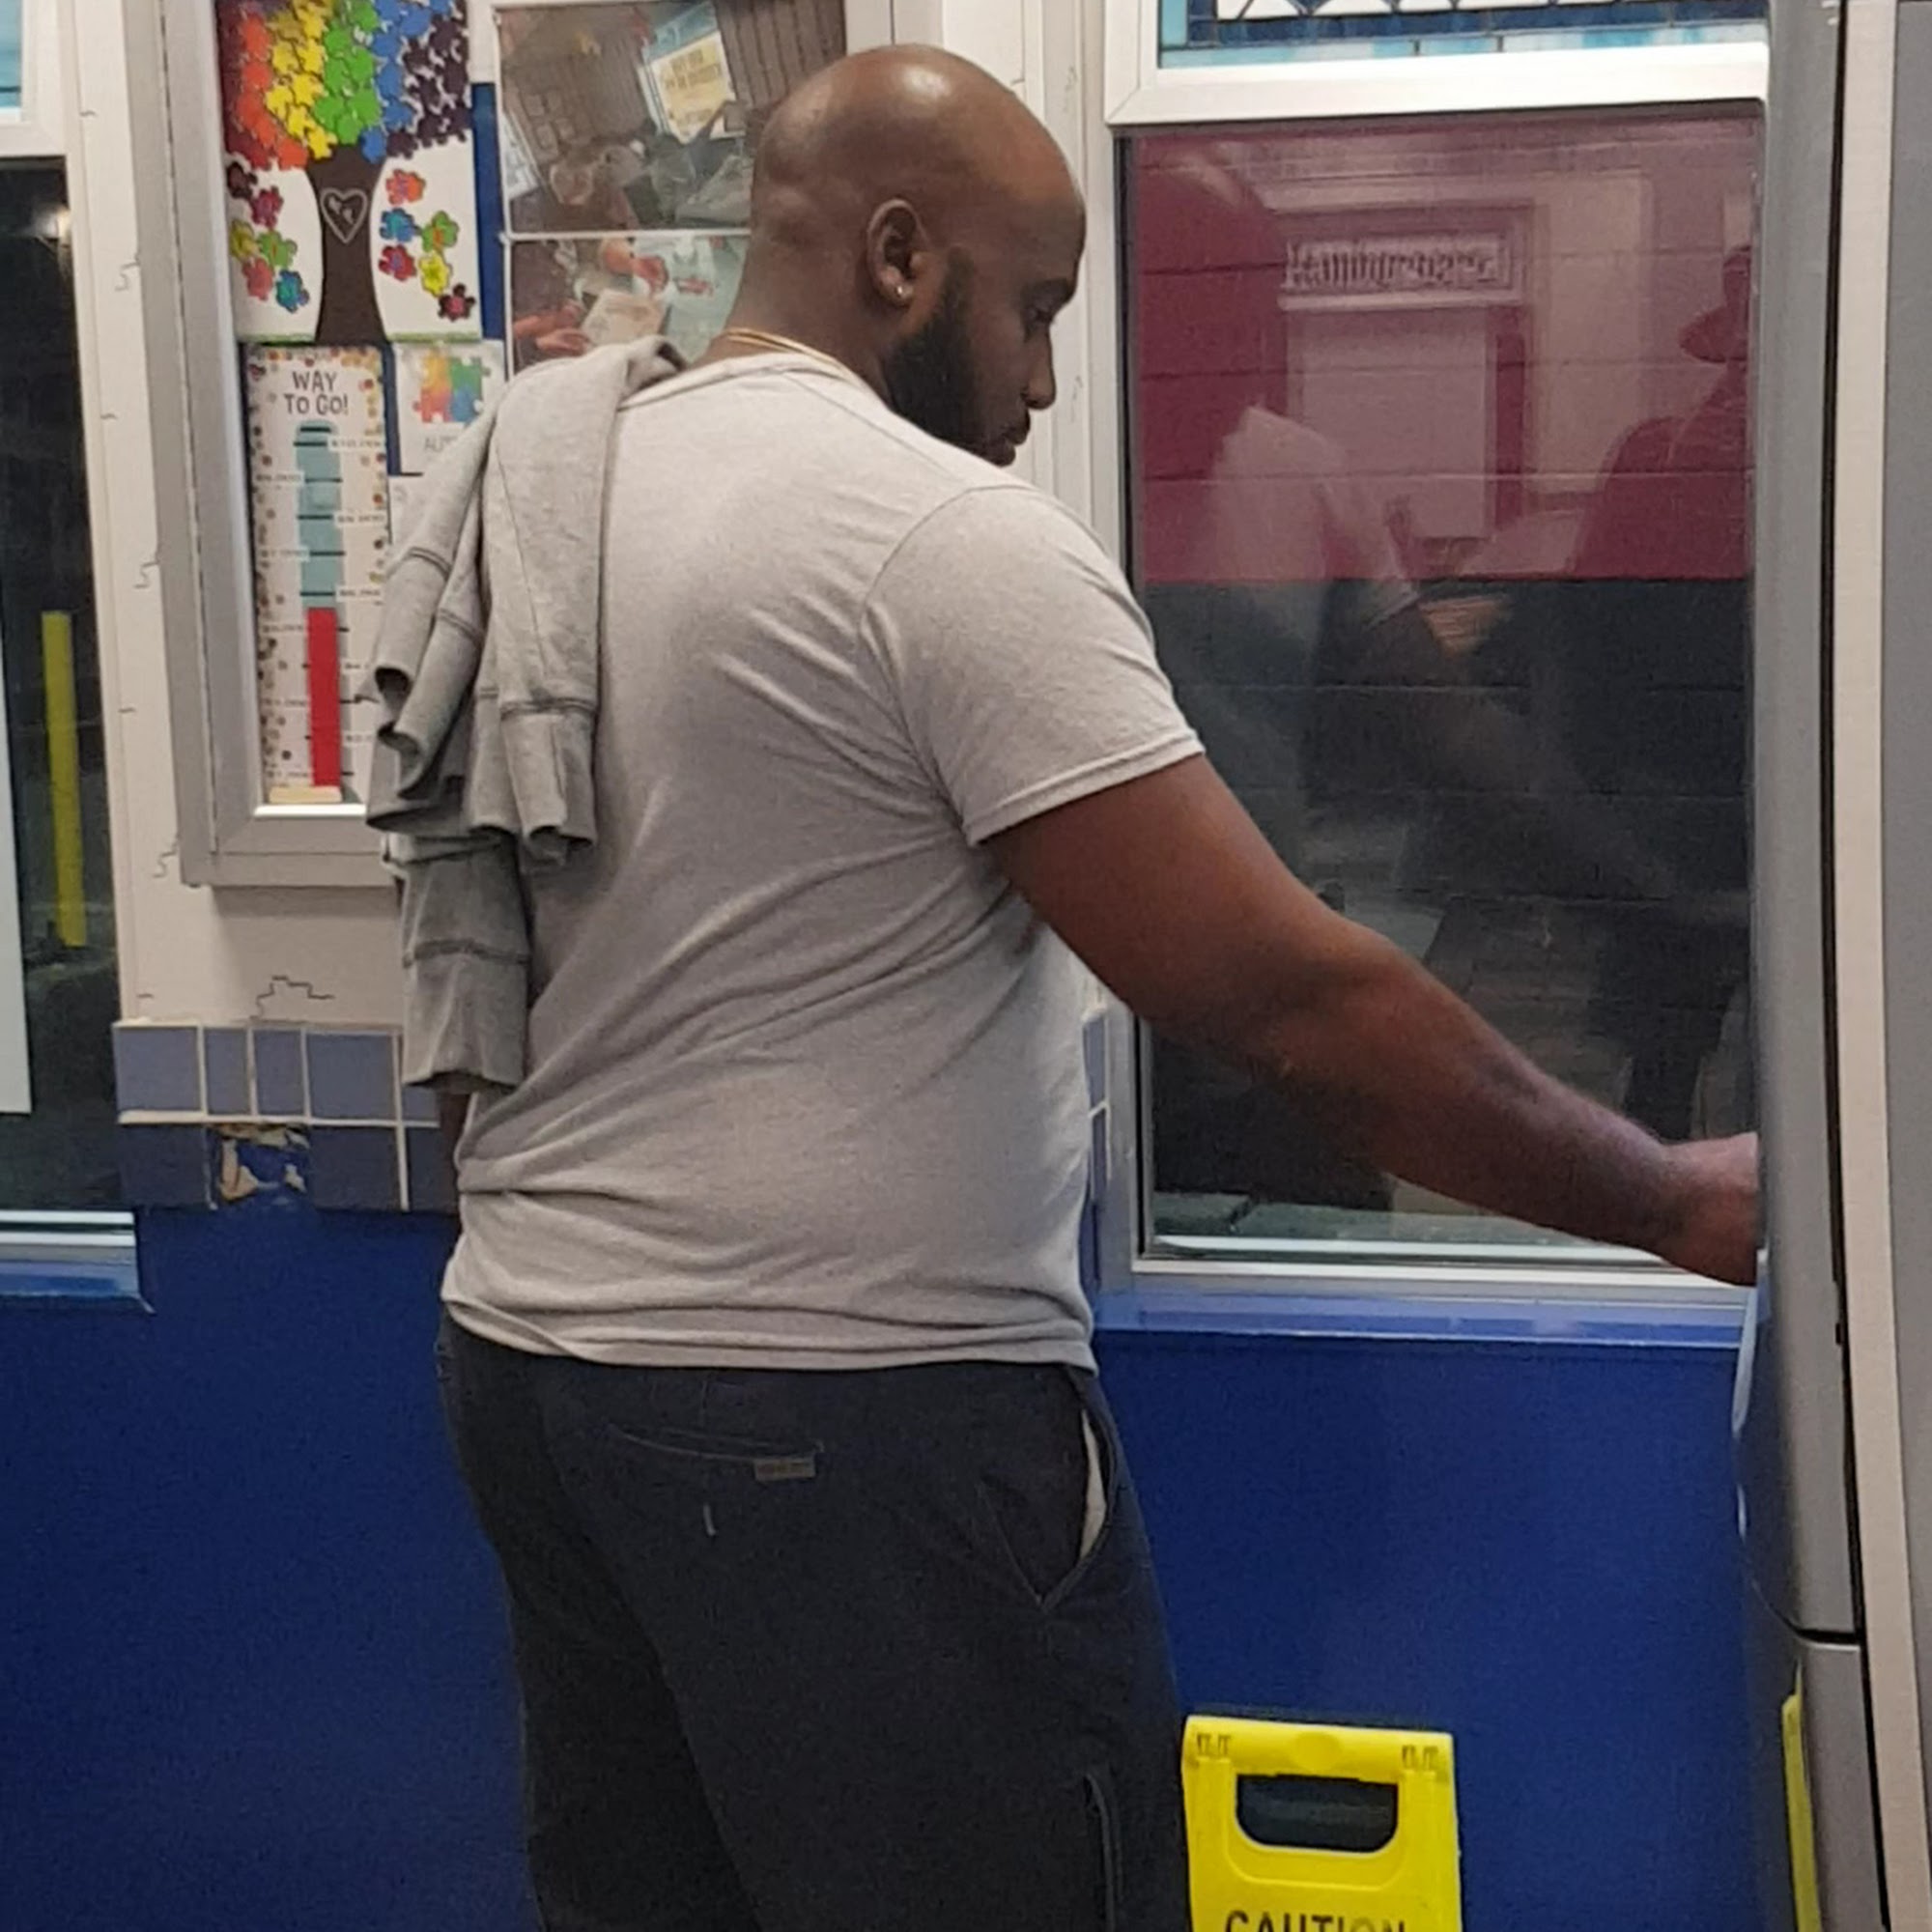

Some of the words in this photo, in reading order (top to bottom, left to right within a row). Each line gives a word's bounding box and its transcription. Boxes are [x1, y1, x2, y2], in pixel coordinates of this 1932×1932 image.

[293, 371, 338, 393] WAY
[284, 393, 310, 414] TO
[316, 393, 349, 415] GO!
